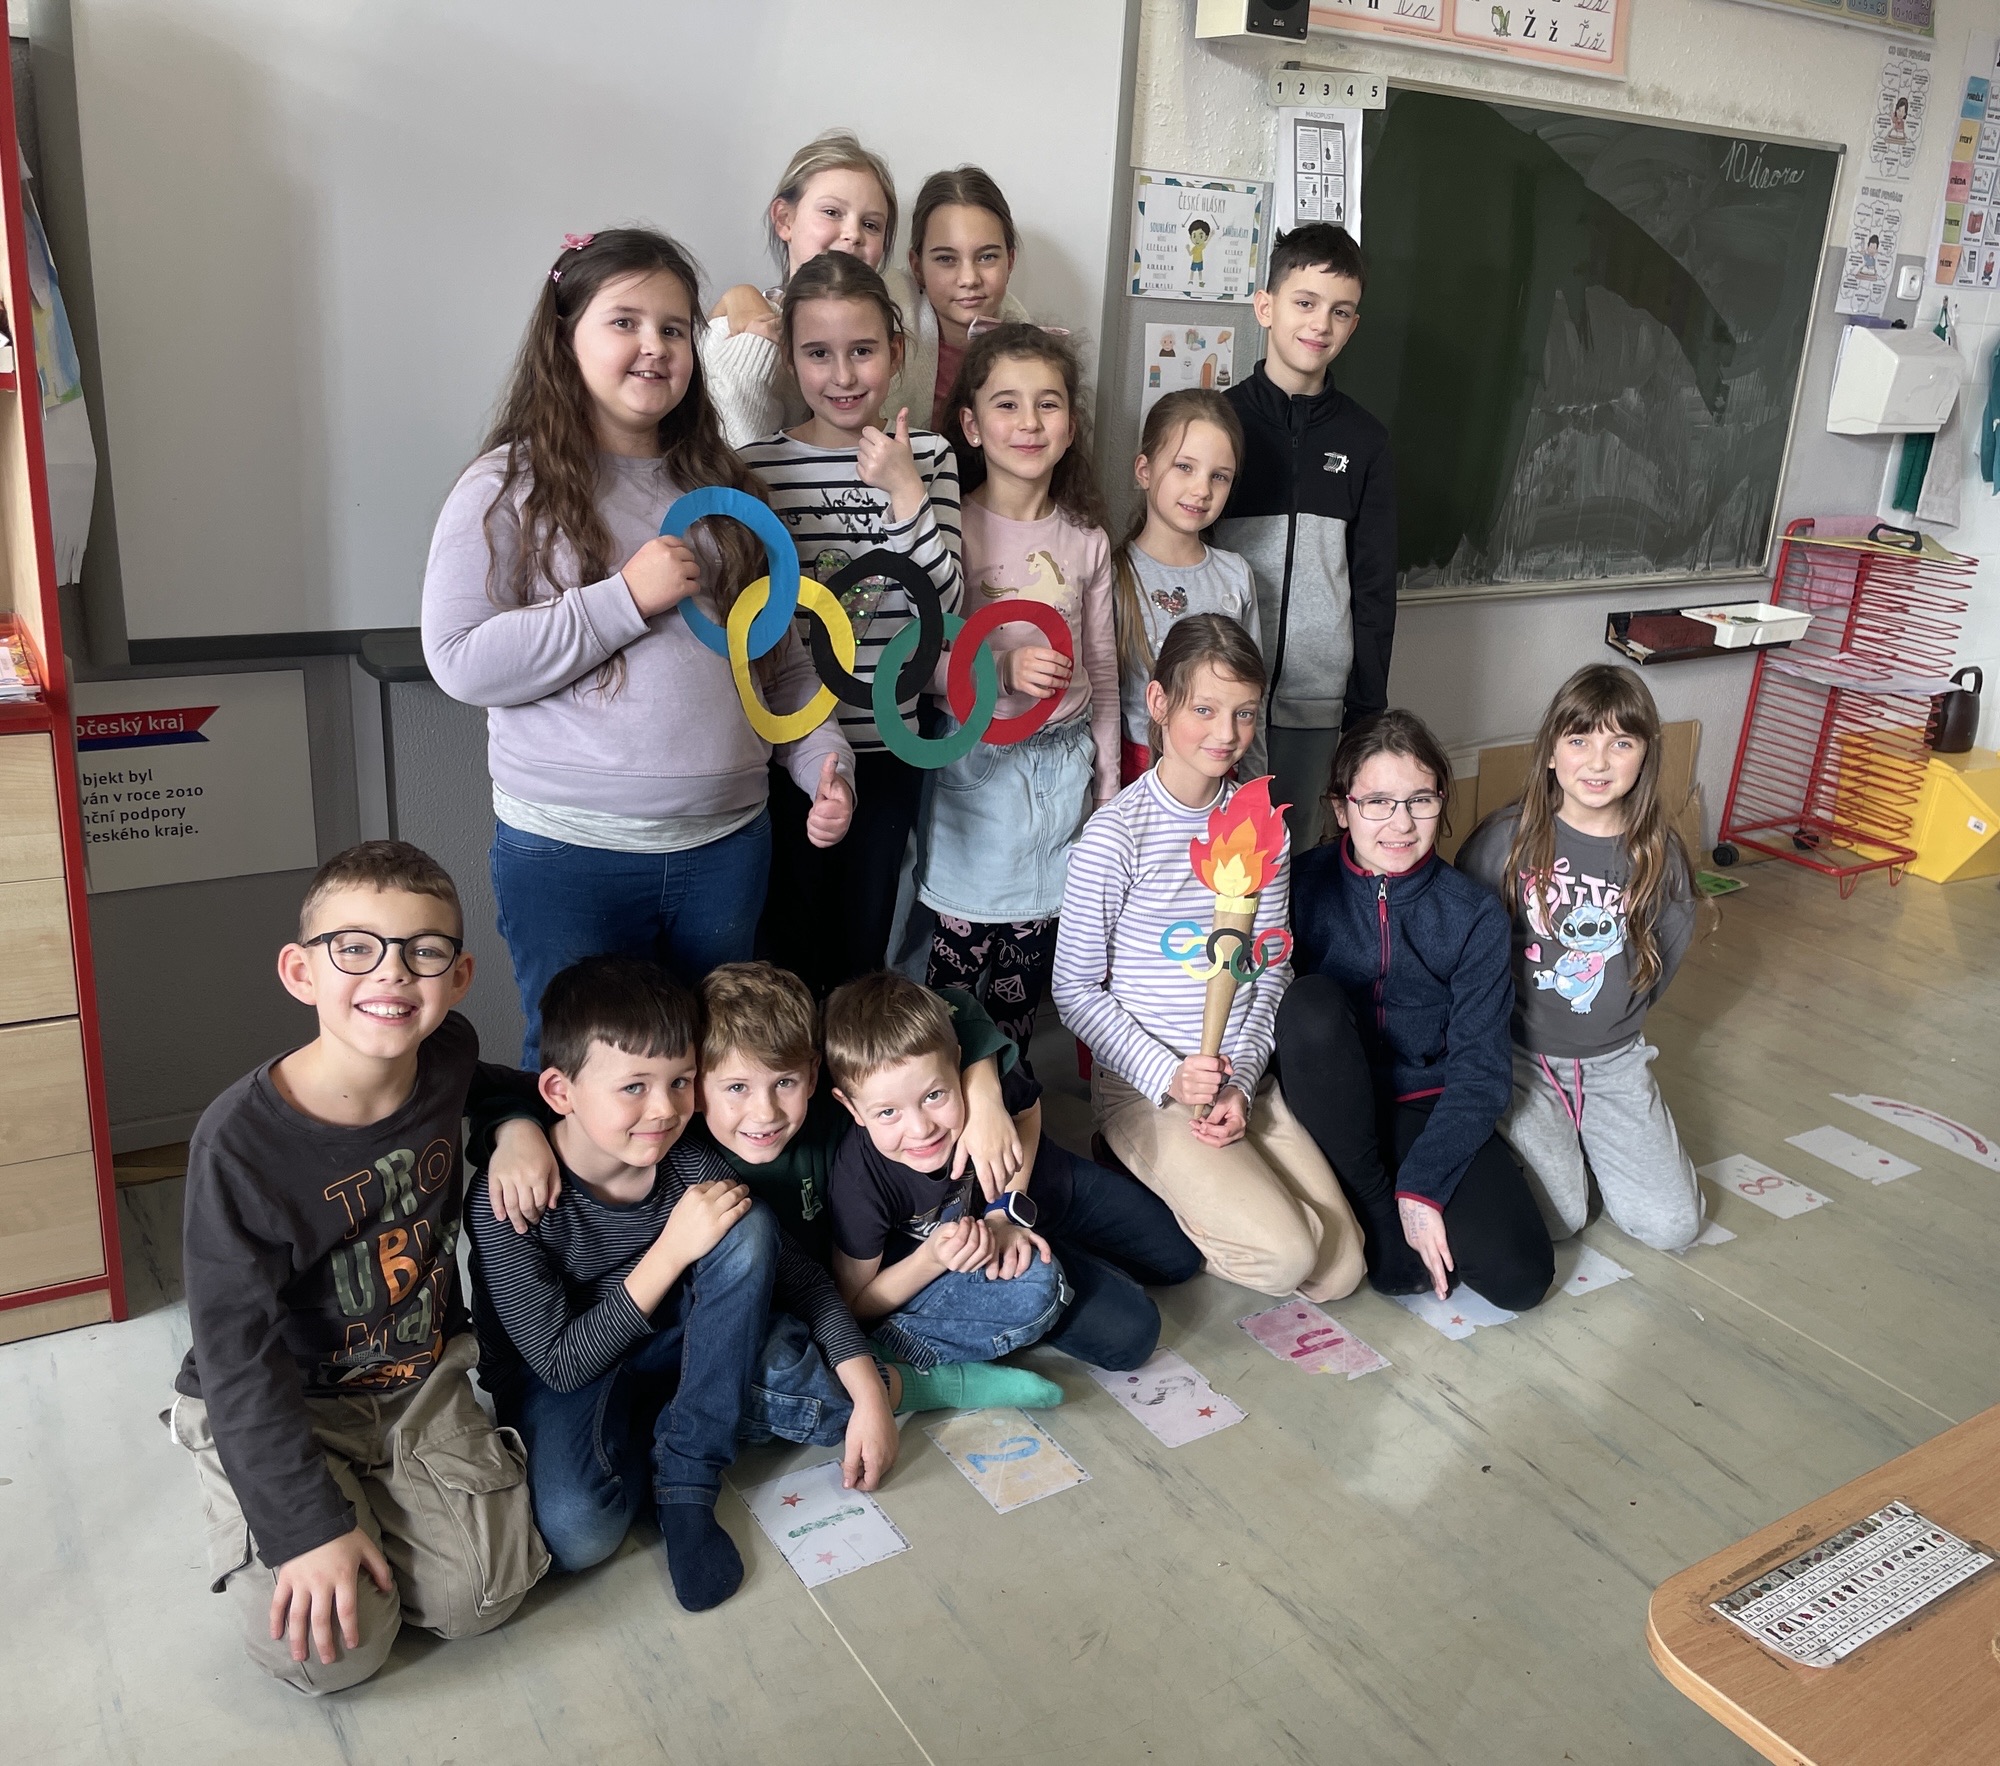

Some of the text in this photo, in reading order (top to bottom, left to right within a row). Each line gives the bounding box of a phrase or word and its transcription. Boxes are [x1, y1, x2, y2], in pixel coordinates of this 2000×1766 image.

[1877, 2, 1886, 14] 90
[1523, 8, 1537, 38] Ž
[1548, 19, 1558, 42] ž
[1277, 81, 1378, 98] 1 2 3 4 5
[1305, 110, 1335, 120] MASOPUST
[1178, 191, 1226, 214] ČESKÉ HLÁSKY
[76, 713, 184, 737] očeský kraj
[129, 768, 153, 785] byl
[113, 793, 122, 803] v
[127, 789, 161, 802] roce
[166, 786, 203, 799] 2010
[120, 806, 187, 825] podpory
[155, 824, 199, 838] kraje.
[324, 1138, 452, 1240] TRO
